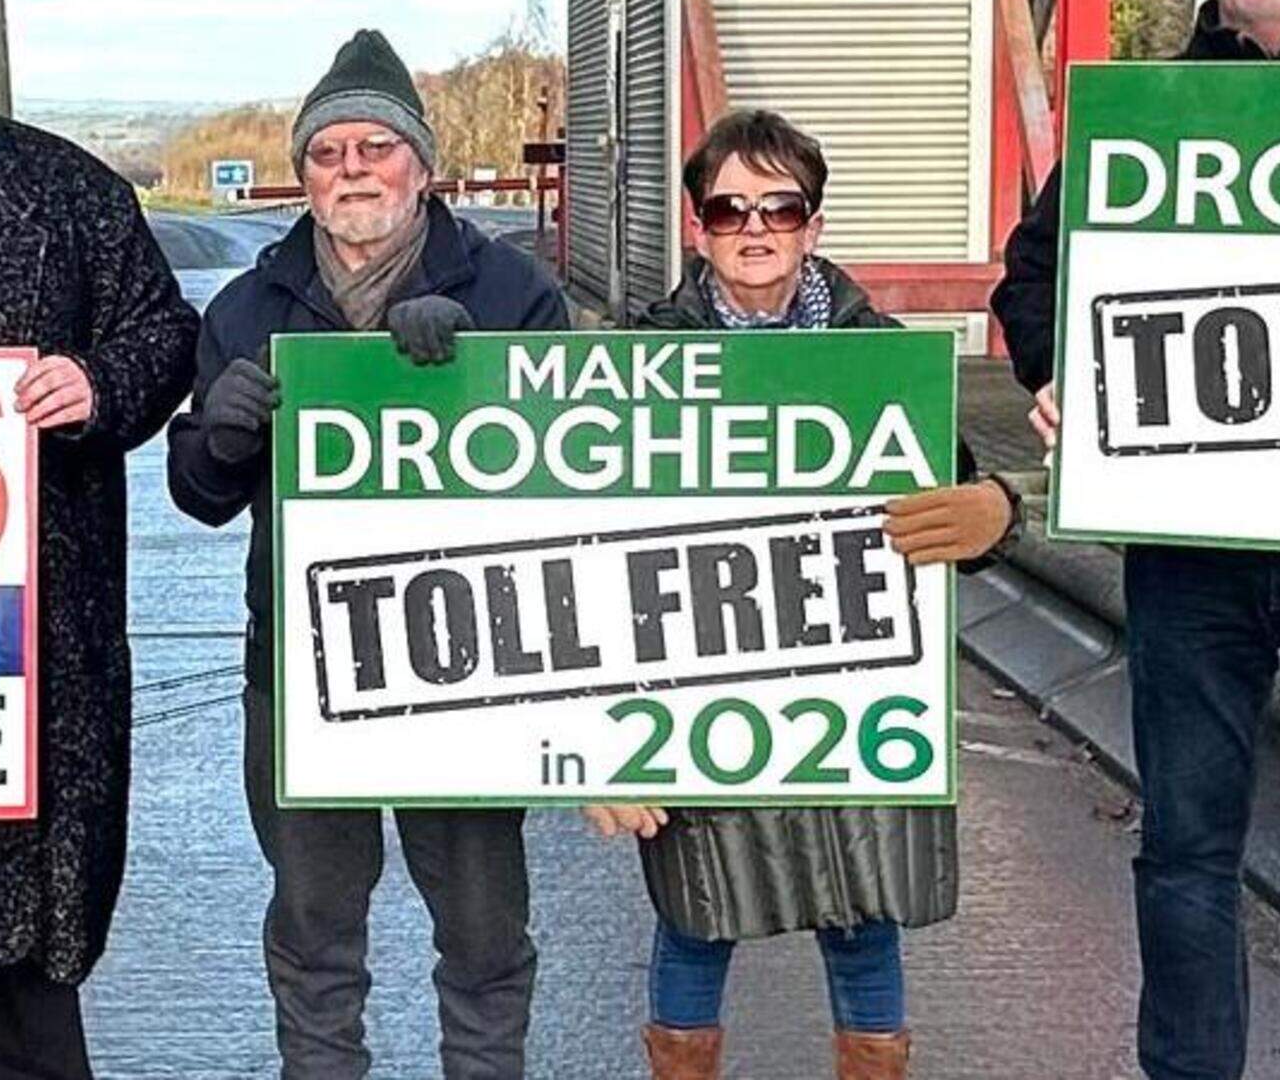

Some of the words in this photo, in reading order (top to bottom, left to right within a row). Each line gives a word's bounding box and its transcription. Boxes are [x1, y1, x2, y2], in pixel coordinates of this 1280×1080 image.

[507, 343, 722, 401] MAKE
[297, 404, 938, 493] DROGHEDA
[326, 558, 602, 693] TOLL
[625, 527, 895, 664] FREE
[540, 740, 587, 786] in
[604, 695, 935, 786] 2026
